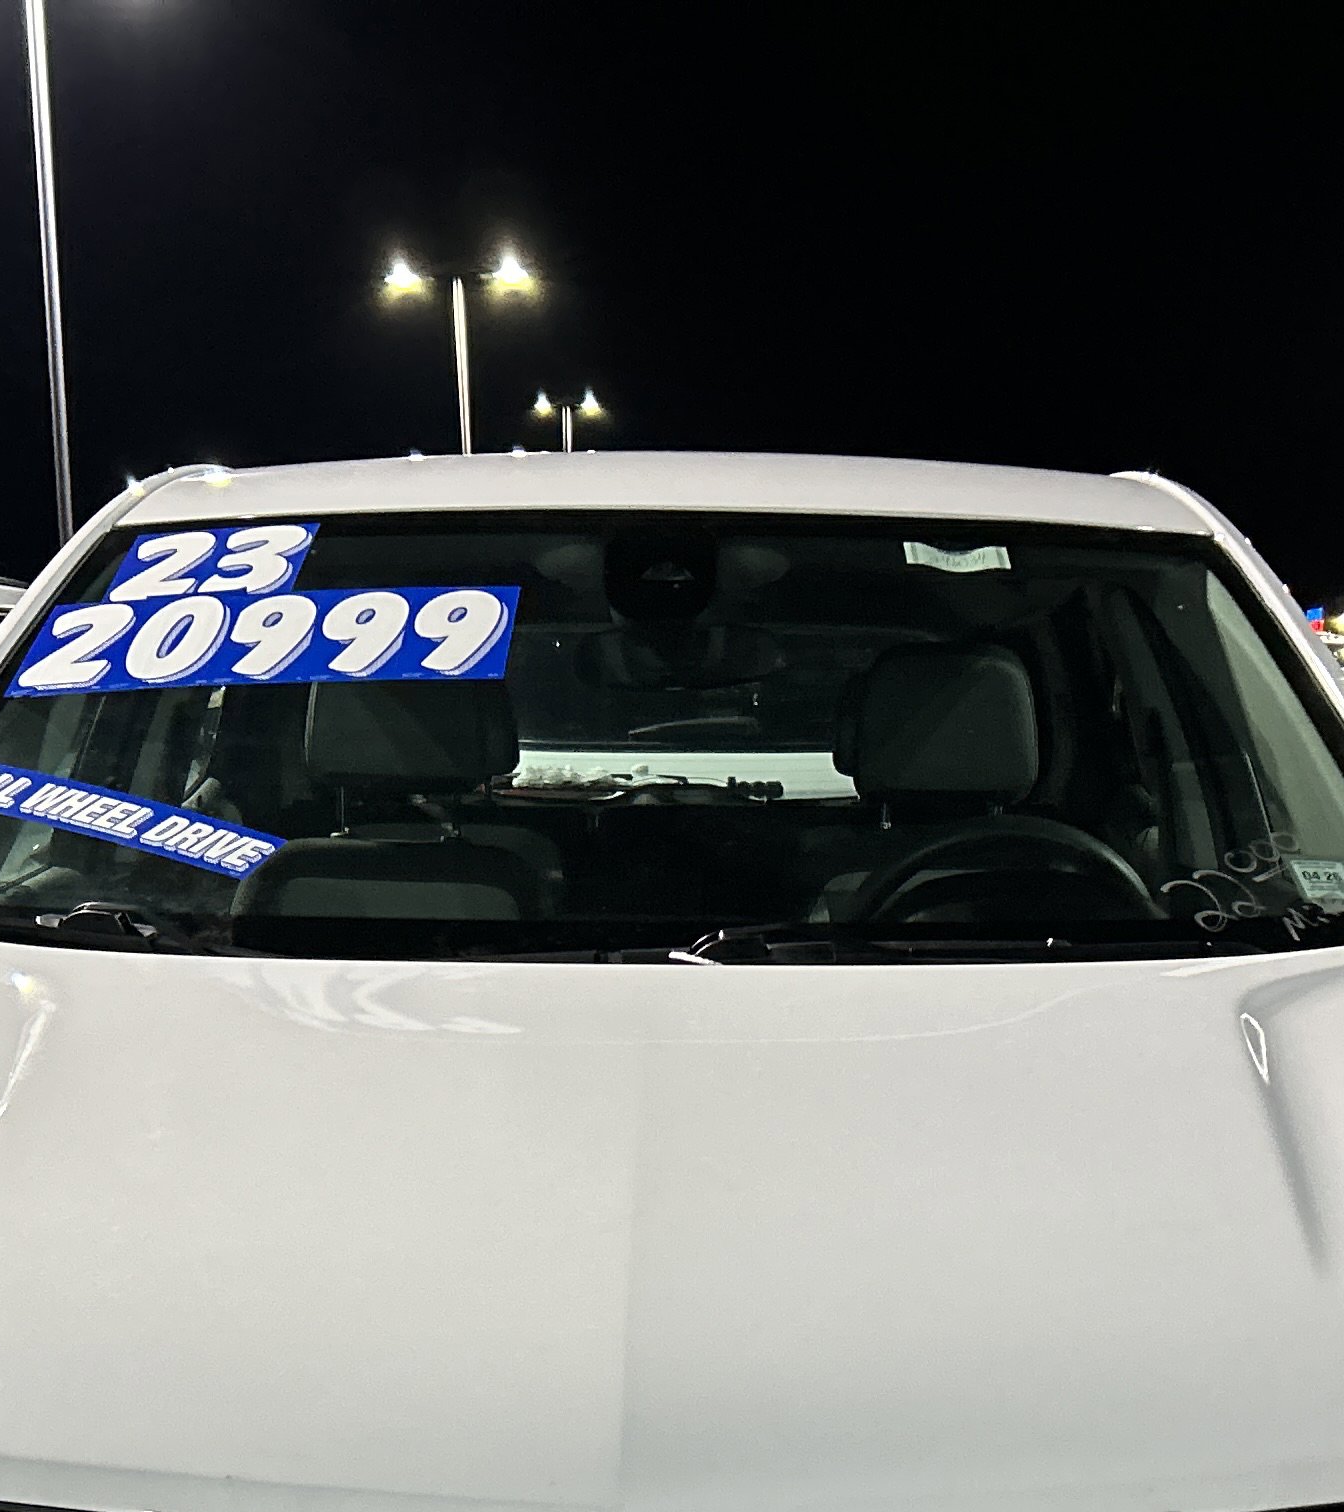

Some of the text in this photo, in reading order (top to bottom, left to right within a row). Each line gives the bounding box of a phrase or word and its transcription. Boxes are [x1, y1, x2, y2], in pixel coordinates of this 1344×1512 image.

[109, 524, 313, 602] 23
[18, 588, 509, 690] 20999
[20, 782, 154, 839] WHEEL
[140, 814, 275, 872] DRIVE
